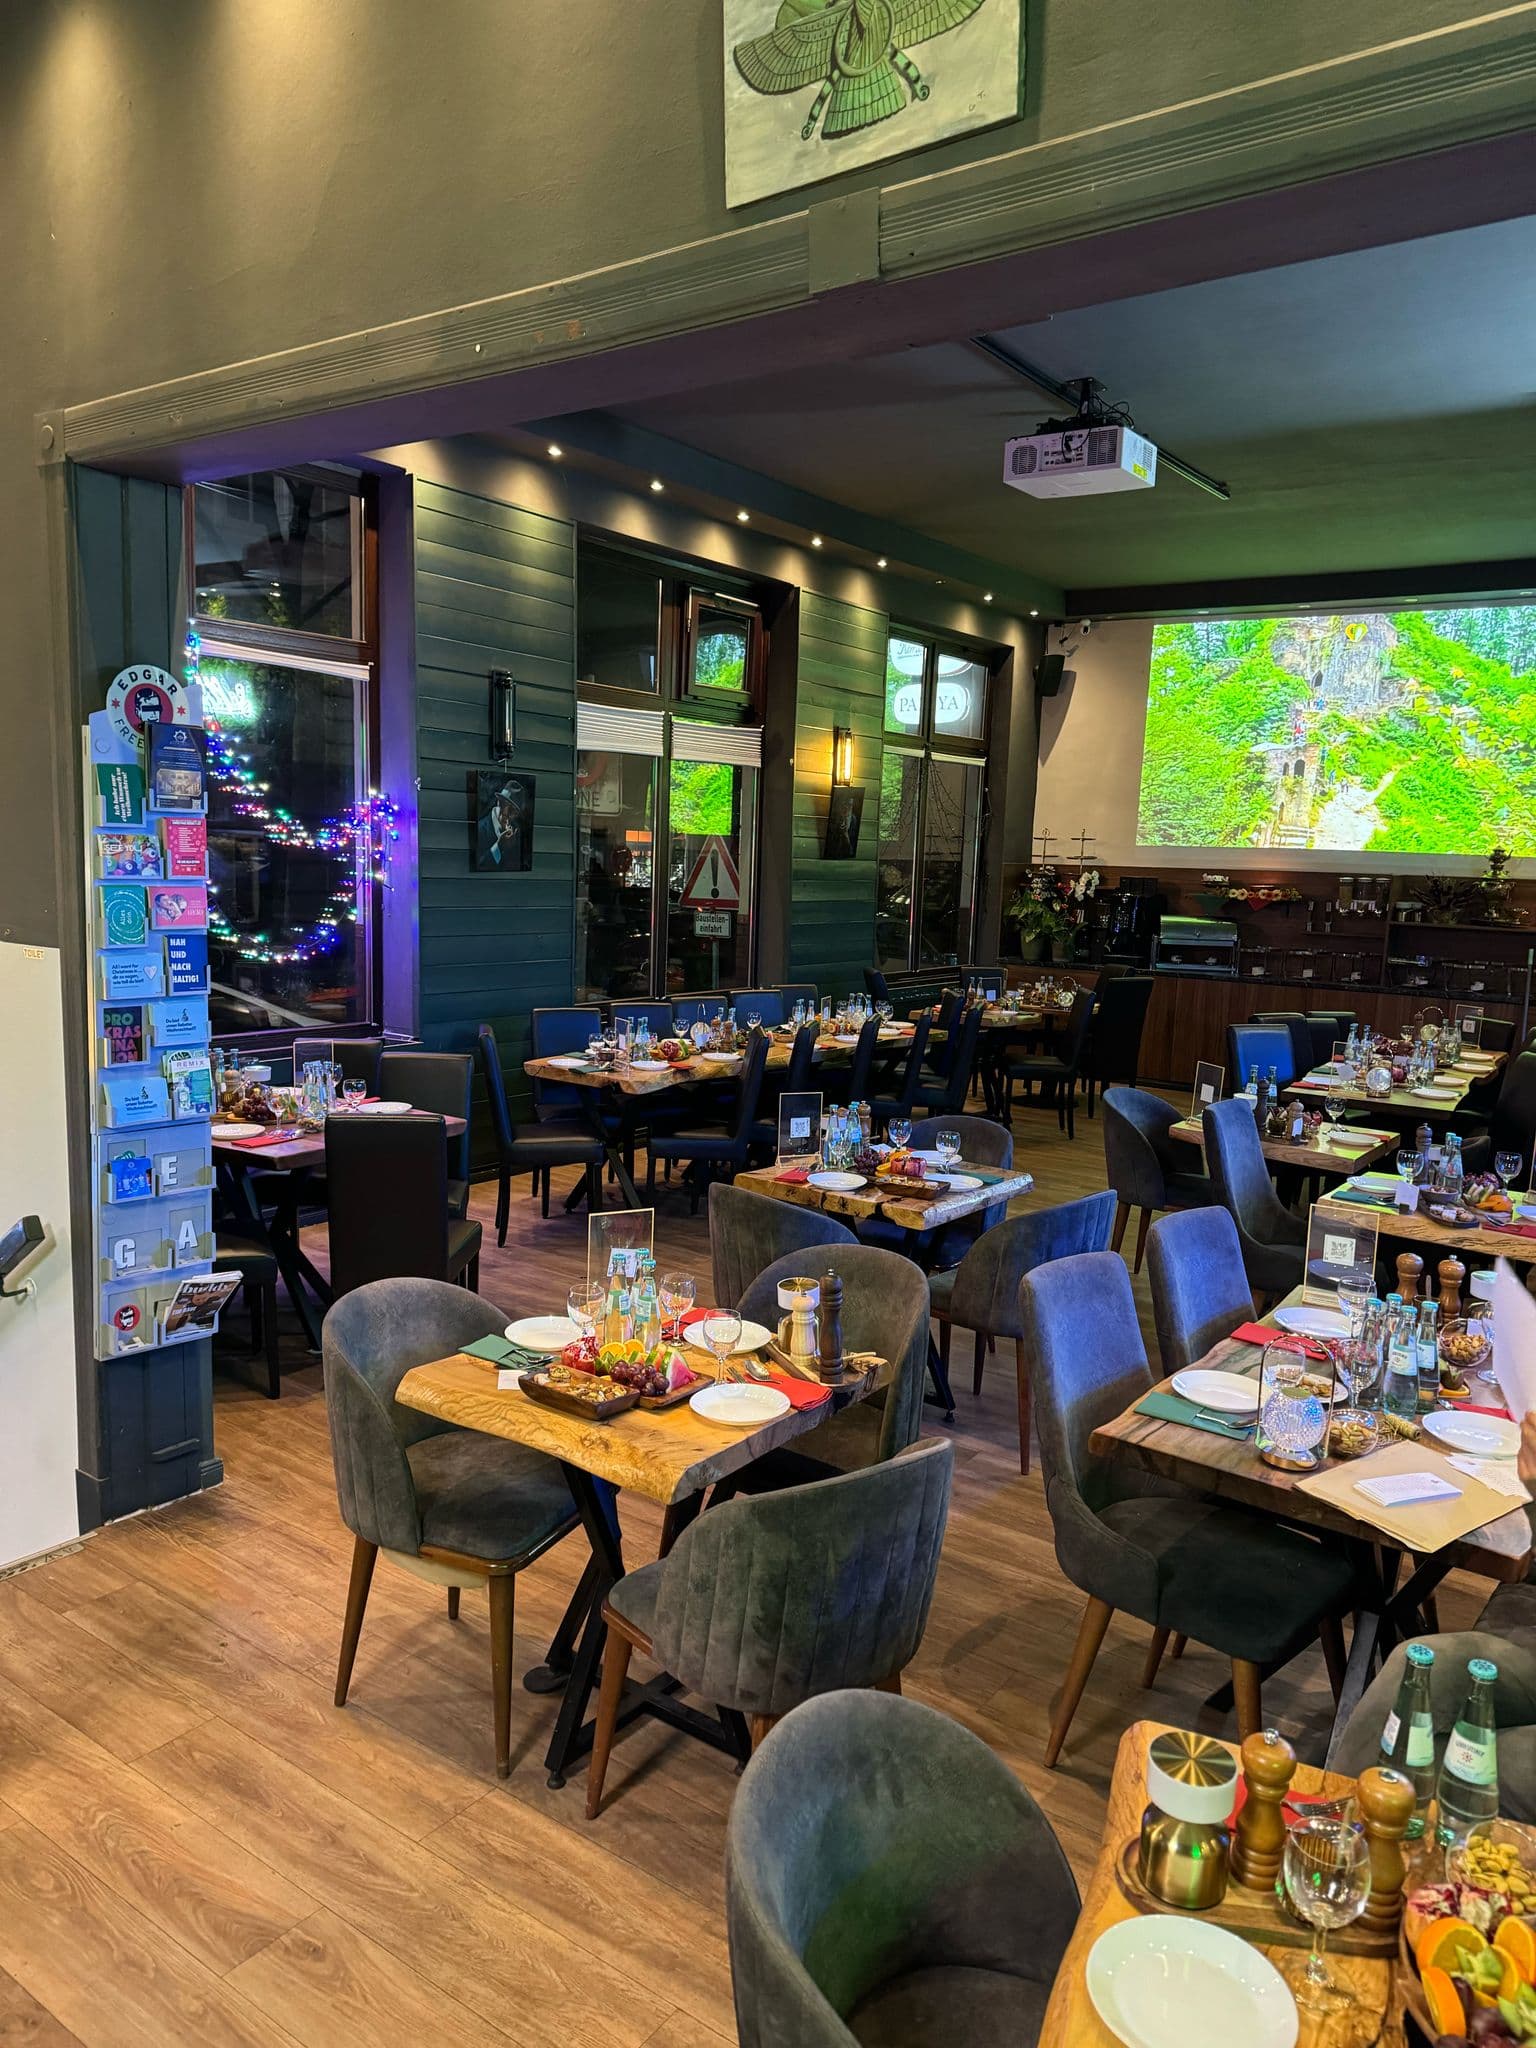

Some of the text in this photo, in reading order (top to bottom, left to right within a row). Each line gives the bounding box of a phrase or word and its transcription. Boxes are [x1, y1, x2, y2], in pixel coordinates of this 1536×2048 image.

[117, 669, 177, 695] EDGAR
[117, 776, 125, 802] Wunsch
[696, 912, 729, 923] Baustellen-
[700, 924, 722, 933] einfahrt
[171, 950, 187, 959] UND
[172, 962, 191, 971] NACH
[173, 974, 199, 983] HALTIG!
[177, 1060, 204, 1068] REMIX
[161, 1156, 177, 1186] E
[179, 1220, 198, 1250] A
[114, 1239, 136, 1269] G
